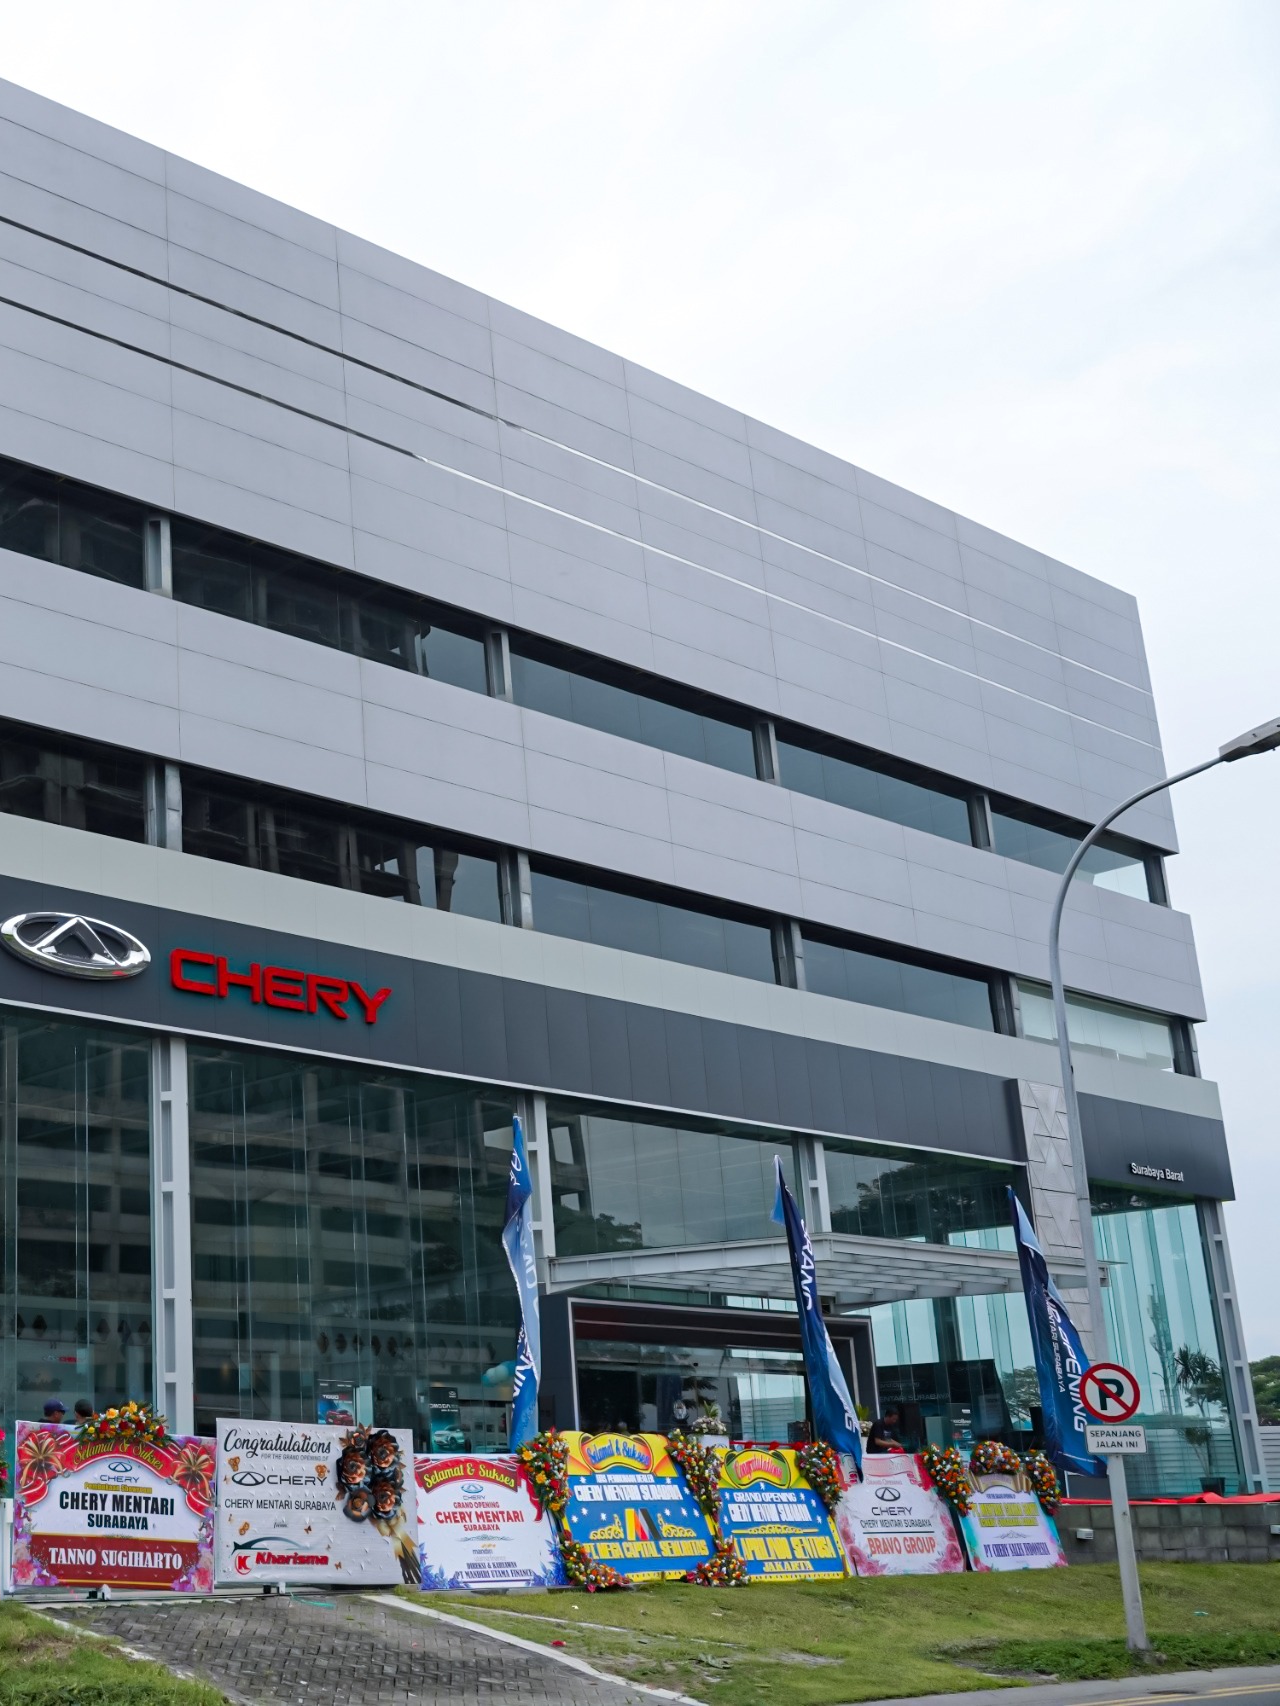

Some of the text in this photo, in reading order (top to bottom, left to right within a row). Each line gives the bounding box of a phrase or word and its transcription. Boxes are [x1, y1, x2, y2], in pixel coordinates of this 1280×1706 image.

[170, 948, 392, 1024] CHERY
[1131, 1162, 1184, 1181] Surabaya Barat
[1052, 1342, 1066, 1393] SURABAYA
[224, 1429, 331, 1458] Congratulations
[74, 1439, 163, 1469] Selamat & Sukses
[100, 1475, 139, 1483] CHERY
[267, 1475, 327, 1486] CHERY
[424, 1463, 514, 1488] Selamat & Sukses
[59, 1491, 174, 1515] CHERY MENTARI
[224, 1499, 336, 1510] CHERY MENTARI SURABAYA
[733, 1492, 797, 1502] GRAND OPENING
[435, 1511, 524, 1523] CHERY MENTARI
[872, 1507, 912, 1515] CHERY
[88, 1514, 148, 1530] SURABAYA
[860, 1520, 878, 1528] CHERY
[904, 1519, 932, 1527] SURABAYA
[867, 1536, 936, 1554] BRAVO GROUP
[49, 1547, 182, 1569] TANNO SUGIHARTO
[256, 1552, 329, 1565] Kharisma
[465, 1570, 490, 1578] MANDIRI
[511, 1569, 532, 1577] FINANCE
